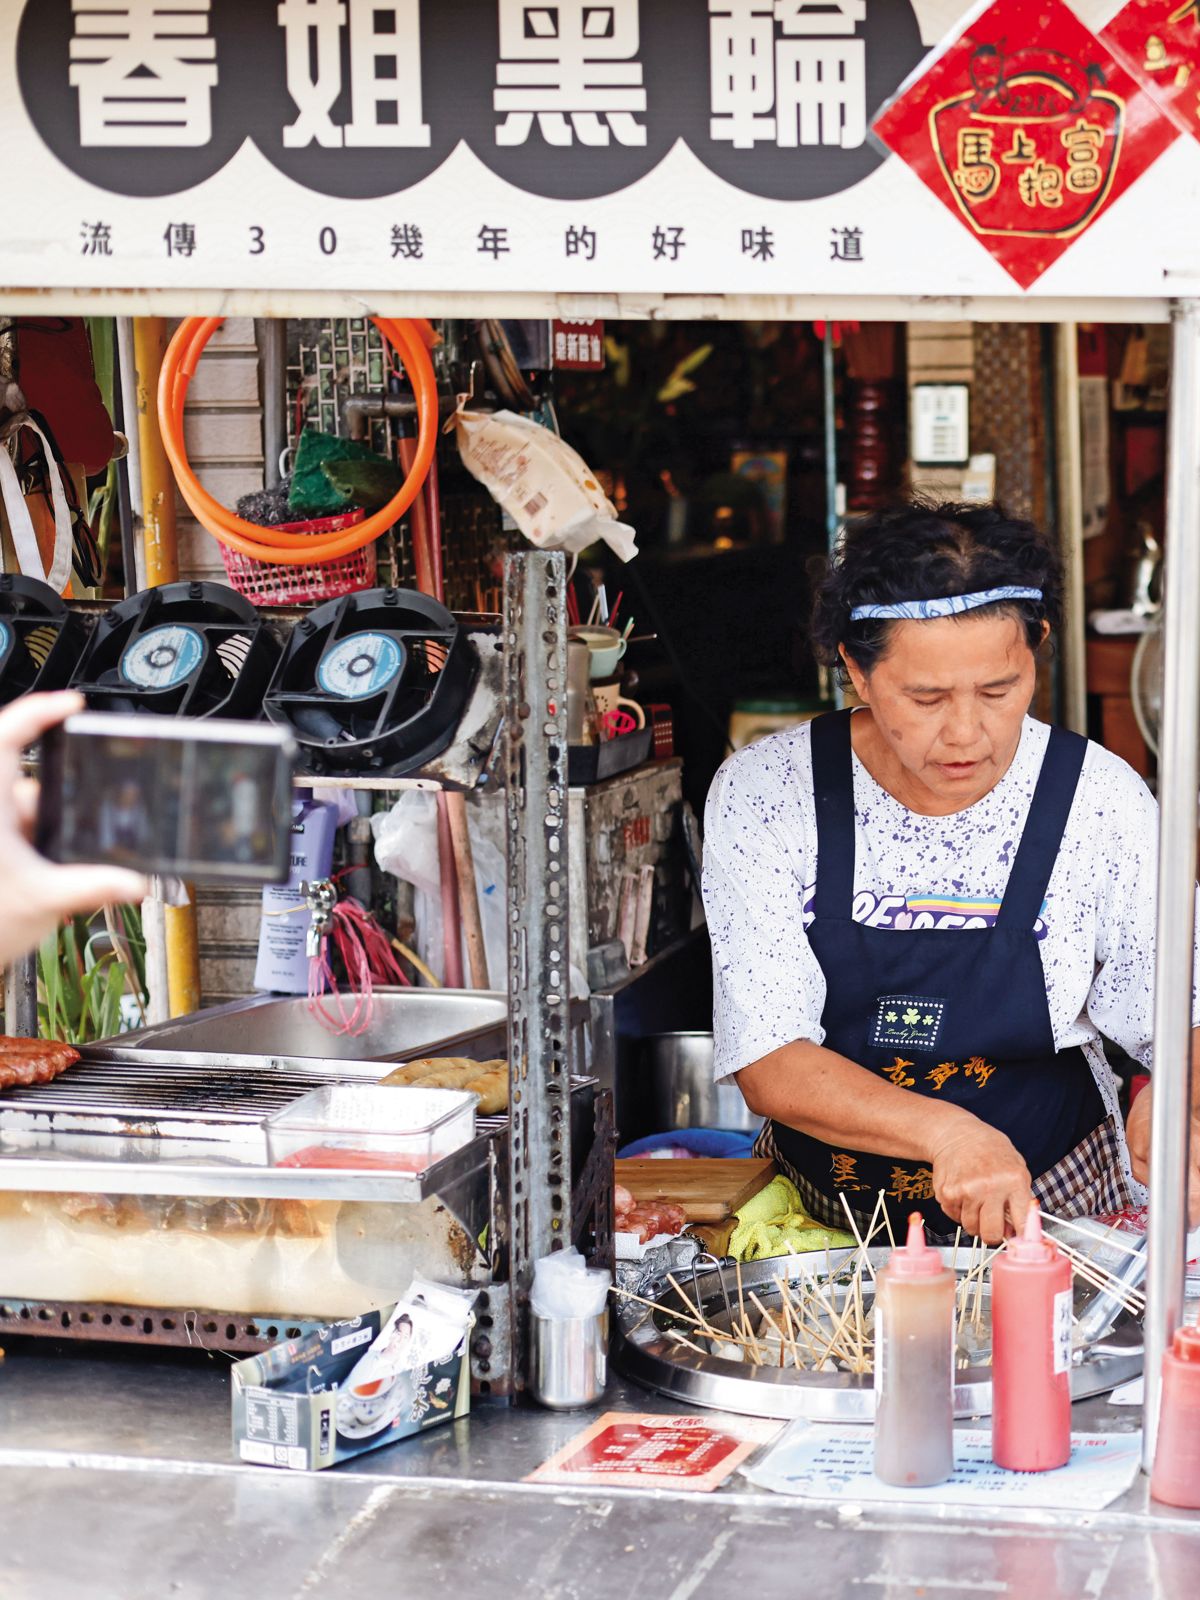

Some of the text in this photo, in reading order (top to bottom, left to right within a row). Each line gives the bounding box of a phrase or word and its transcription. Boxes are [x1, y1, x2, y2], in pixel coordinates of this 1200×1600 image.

[69, 0, 867, 150] 春姐黑輪
[80, 221, 865, 262] 流傳30幾年的好味道
[830, 1152, 936, 1204] 黑輪
